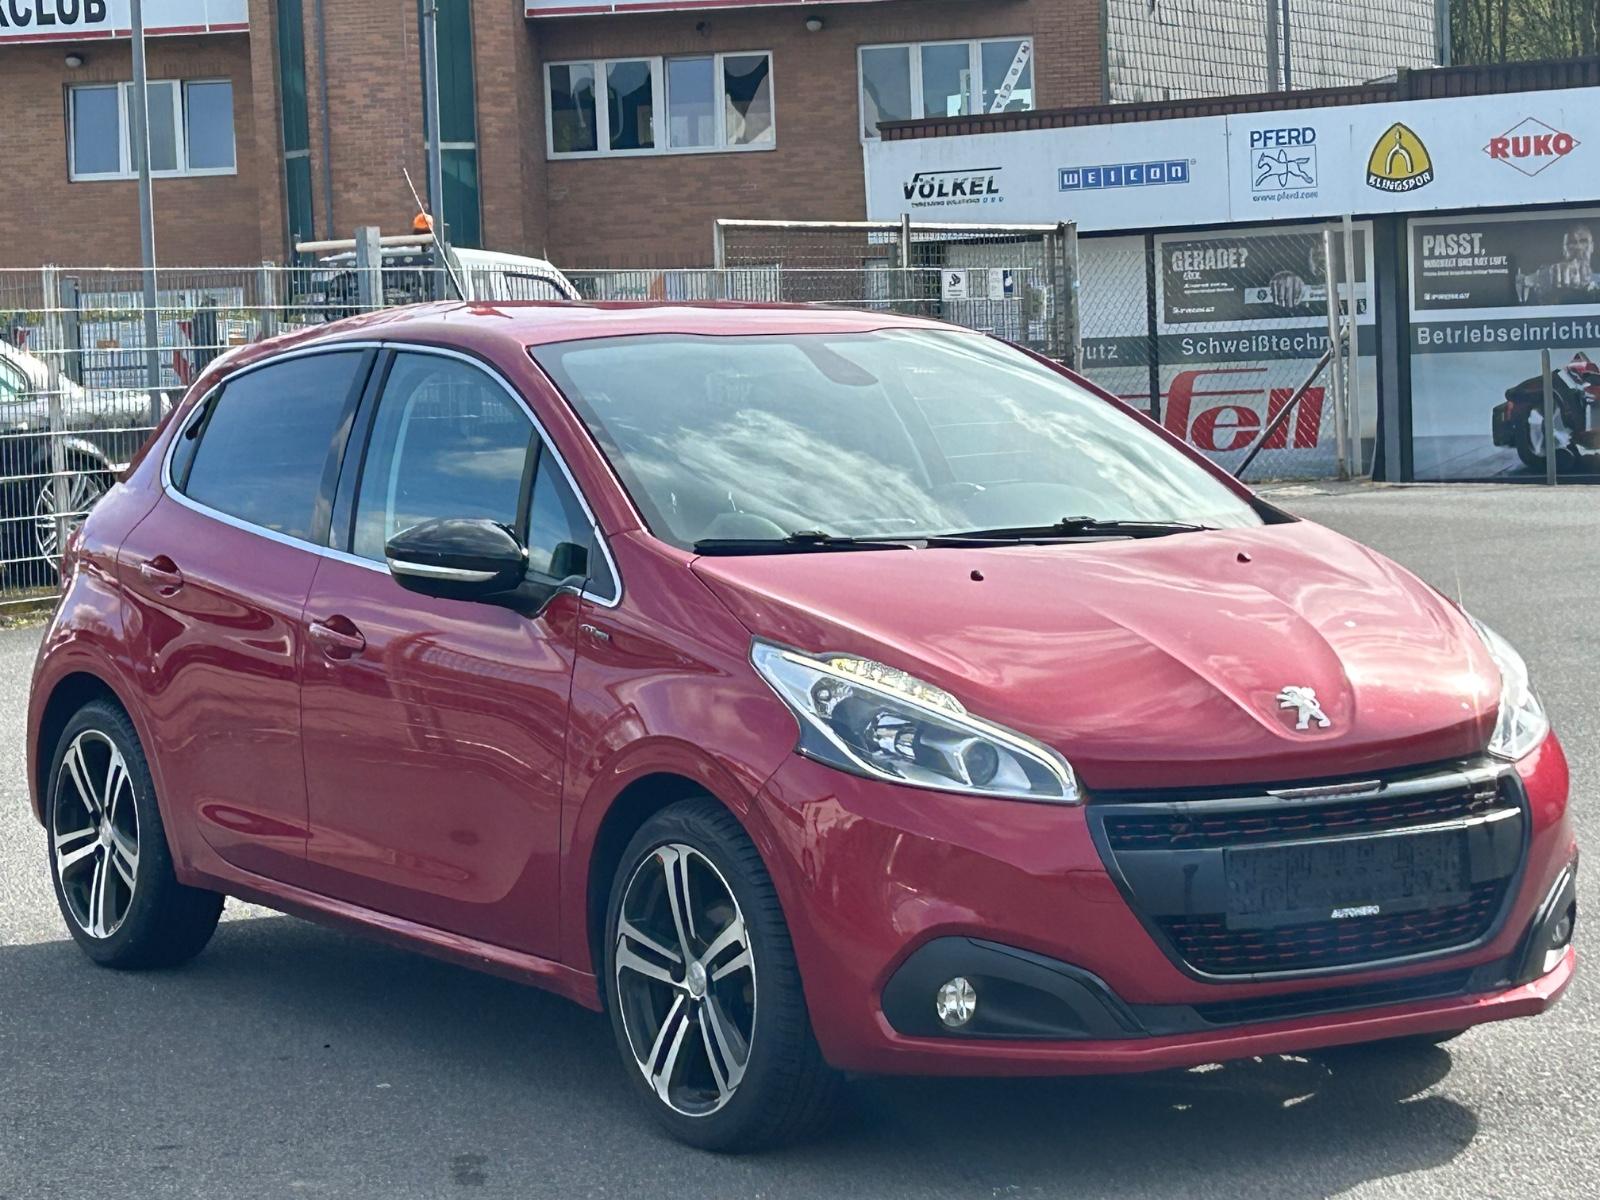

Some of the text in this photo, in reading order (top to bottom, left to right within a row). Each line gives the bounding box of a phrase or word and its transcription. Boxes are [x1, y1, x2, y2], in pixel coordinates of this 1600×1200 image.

[1250, 127, 1316, 147] PFERD
[1490, 133, 1573, 159] RUKO
[903, 174, 1000, 200] VÖLKEL
[1369, 172, 1431, 191] KLINGSPOR
[1423, 232, 1486, 256] PASST,
[1172, 247, 1249, 272] GERADE?
[1083, 344, 1118, 359] utz
